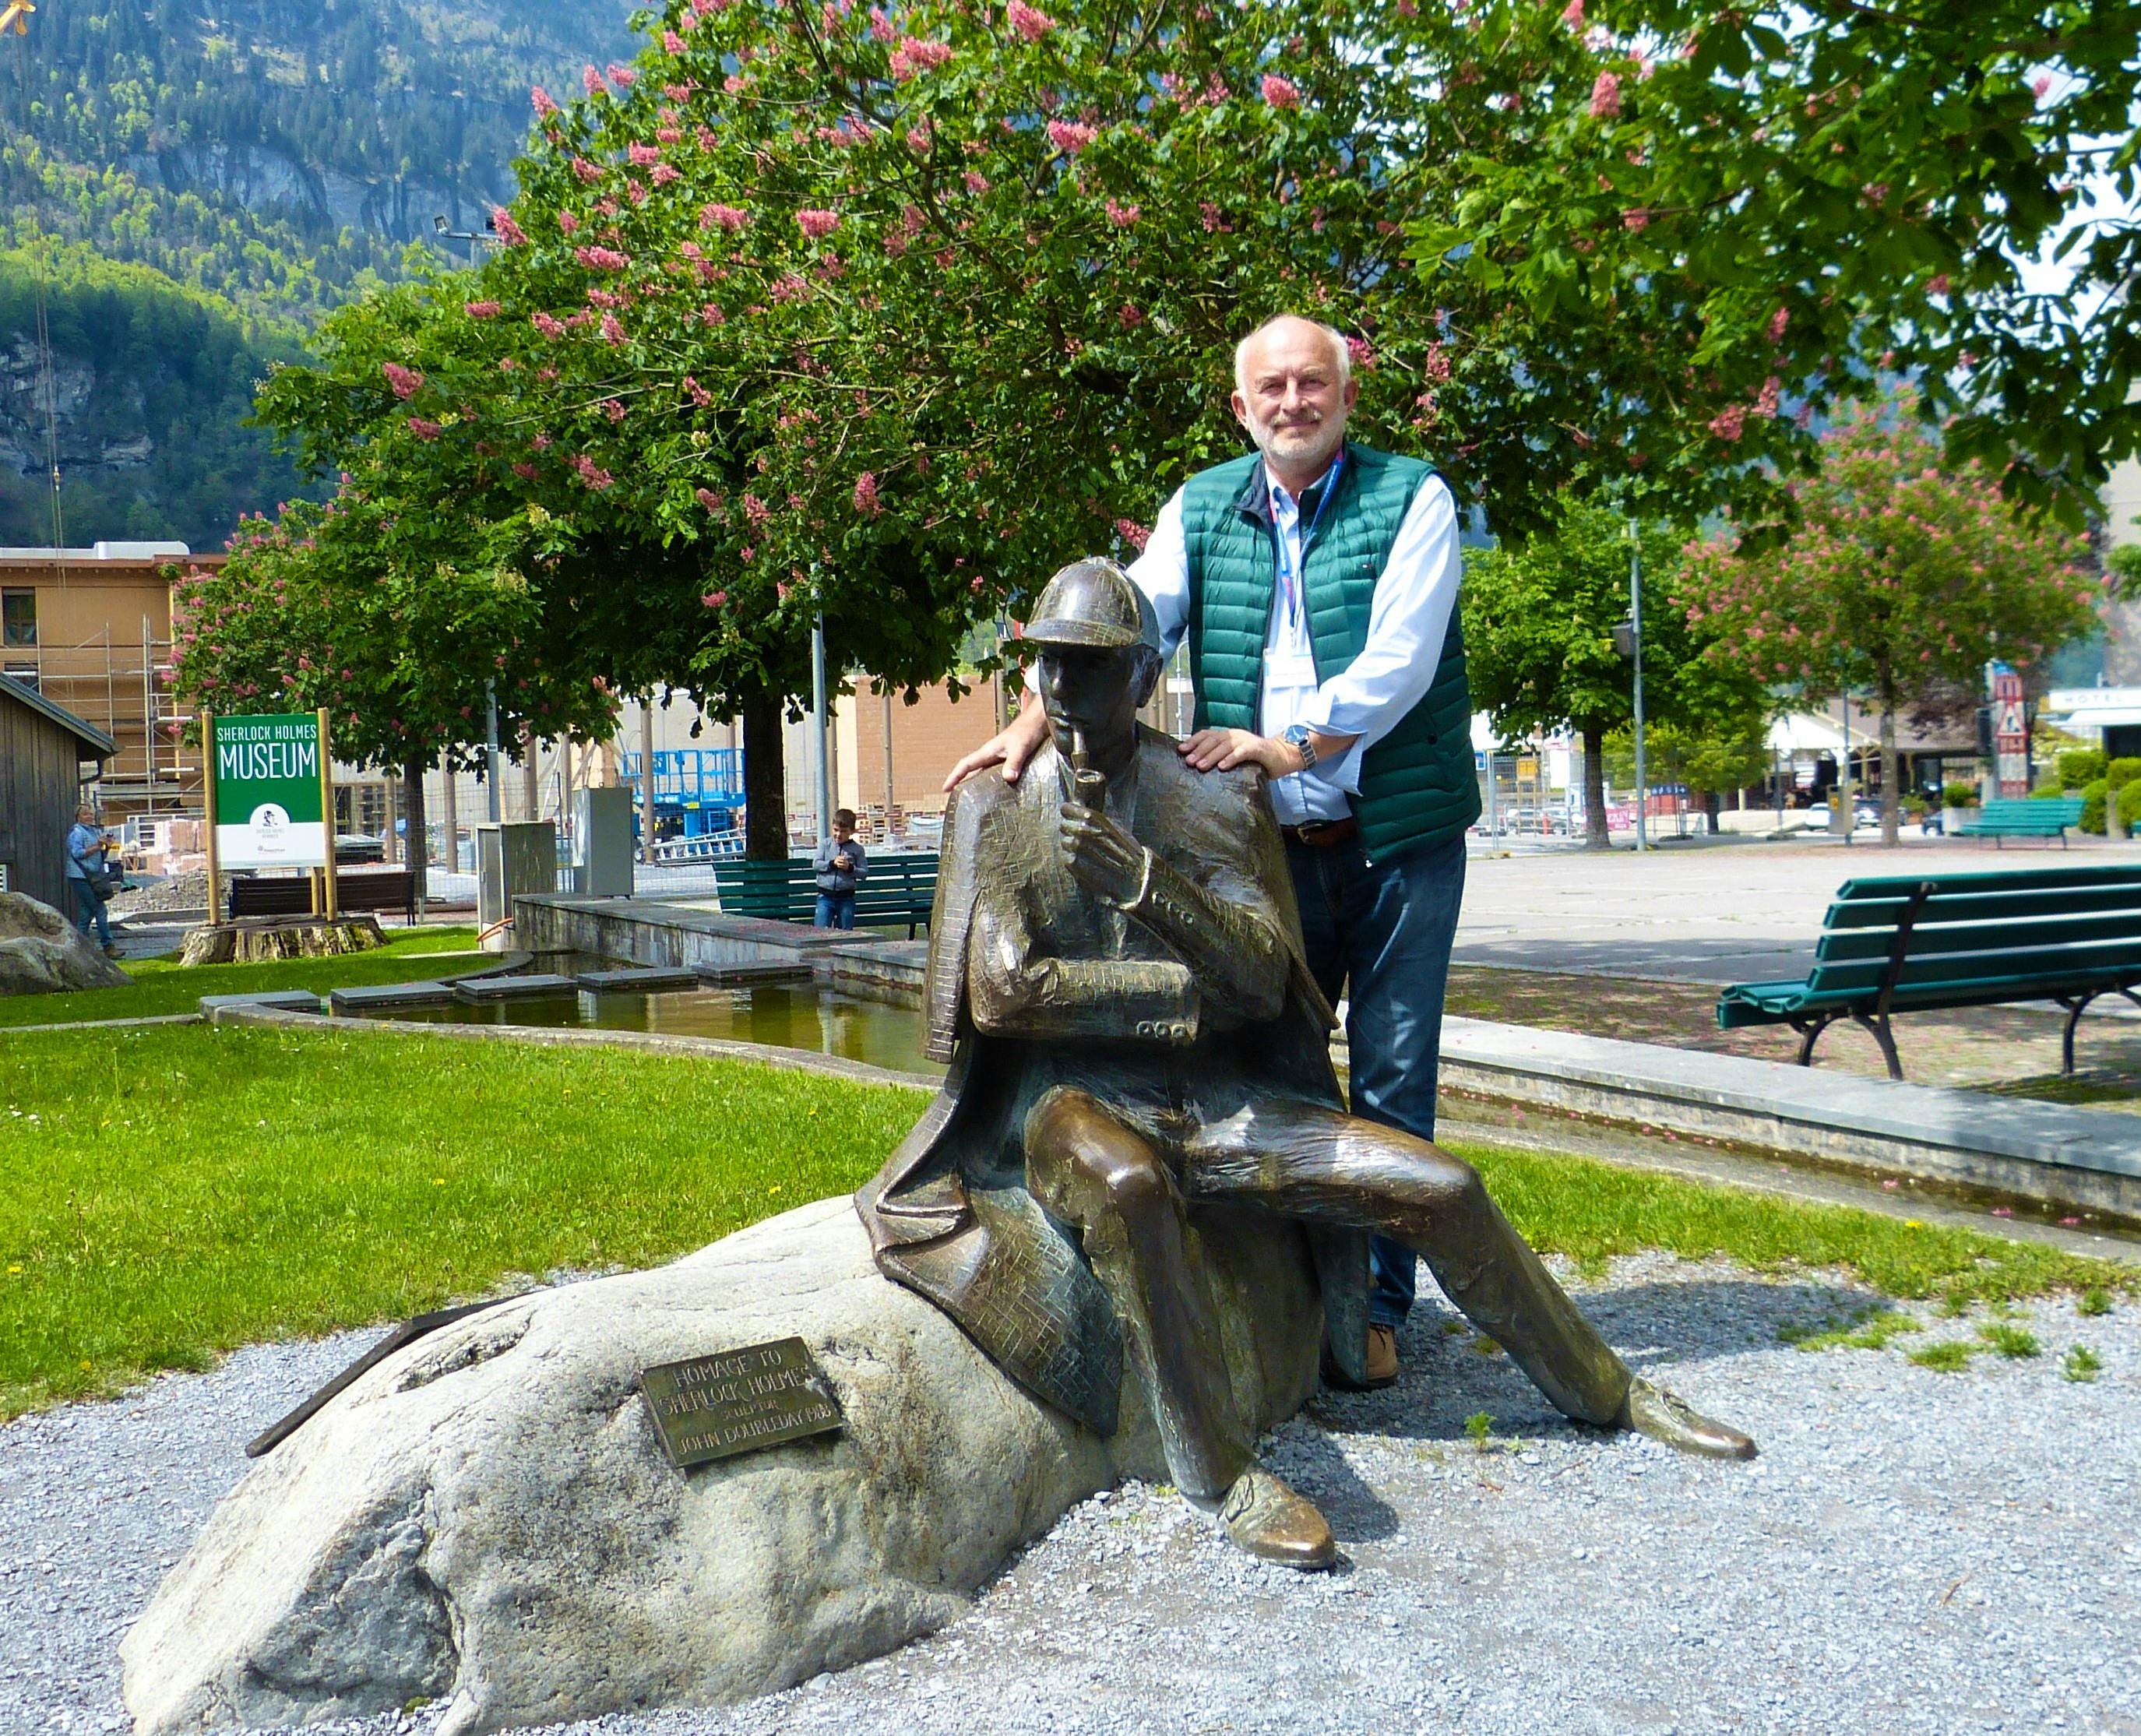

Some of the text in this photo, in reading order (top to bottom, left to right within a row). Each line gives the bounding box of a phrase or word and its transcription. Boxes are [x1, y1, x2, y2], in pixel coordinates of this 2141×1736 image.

[2065, 694, 2122, 703] HOTEL
[217, 725, 317, 741] SHERLOCK HOLMES
[220, 742, 316, 780] MUSEUM
[673, 1349, 782, 1388] HOMAGE TO
[658, 1364, 814, 1416] SHERLOCK HOLMES
[721, 1399, 781, 1421] SCULPTOR
[678, 1431, 720, 1455] JOHN
[724, 1409, 805, 1443] DOUBLEDAY
